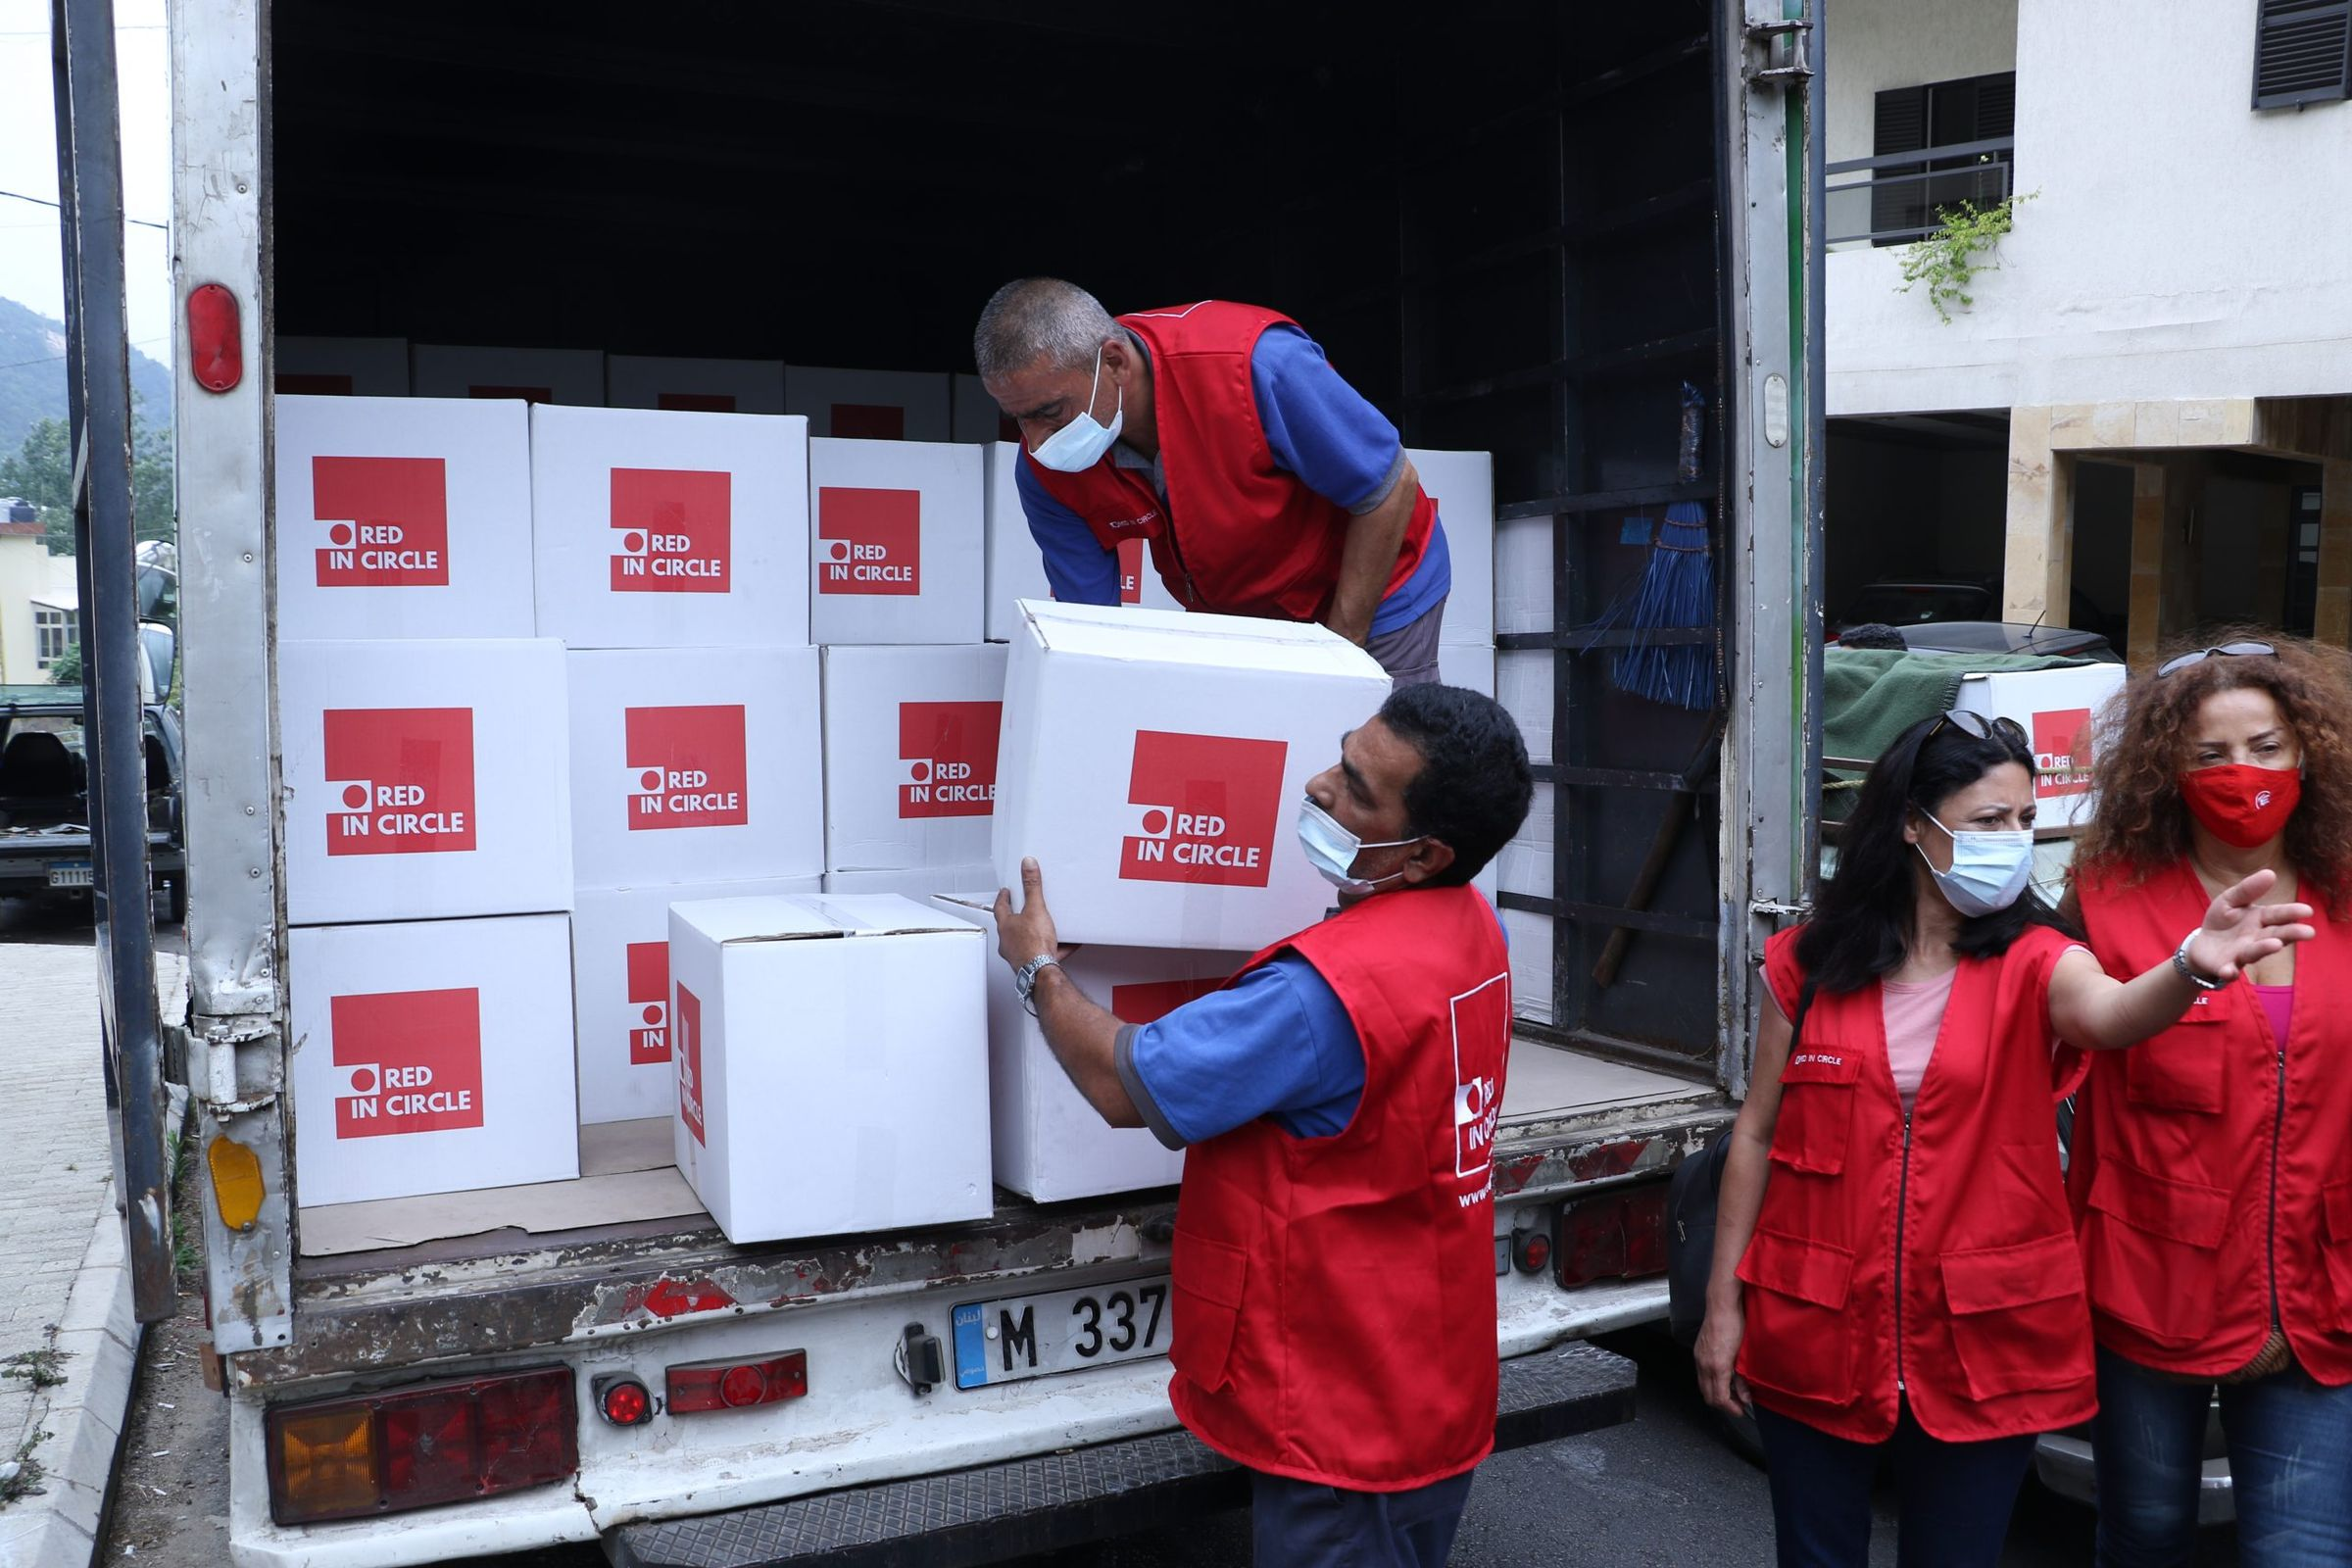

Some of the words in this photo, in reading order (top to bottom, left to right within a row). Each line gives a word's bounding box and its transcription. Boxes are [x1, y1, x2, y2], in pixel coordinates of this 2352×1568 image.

[360, 525, 404, 544] RED
[651, 534, 691, 553] RED
[329, 551, 354, 569] IN
[361, 550, 438, 569] CIRCLE
[854, 544, 887, 561] RED
[622, 557, 645, 576] IN
[651, 558, 721, 577] CIRCLE
[830, 564, 849, 580] IN
[853, 564, 912, 581] CIRCLE
[667, 769, 708, 789] RED
[936, 762, 971, 780] RED
[2040, 774, 2052, 787] IN
[376, 785, 425, 808] RED
[640, 795, 662, 814] IN
[667, 792, 738, 813] CIRCLE
[910, 786, 930, 803] IN
[935, 784, 996, 802] CIRCLE
[342, 814, 369, 837] IN
[376, 811, 465, 836] CIRCLE
[1176, 813, 1226, 837] RED
[1137, 840, 1165, 862] IN
[1172, 842, 1260, 868] CIRCLE
[642, 1029, 664, 1049] IN
[1817, 1054, 1842, 1065] CIRCLE
[384, 1065, 433, 1089] RED
[351, 1097, 378, 1119] IN
[385, 1089, 471, 1116] CIRCLE
[1469, 1124, 1485, 1150] IN
[1000, 1304, 1038, 1371] M
[1072, 1283, 1167, 1358] 337
